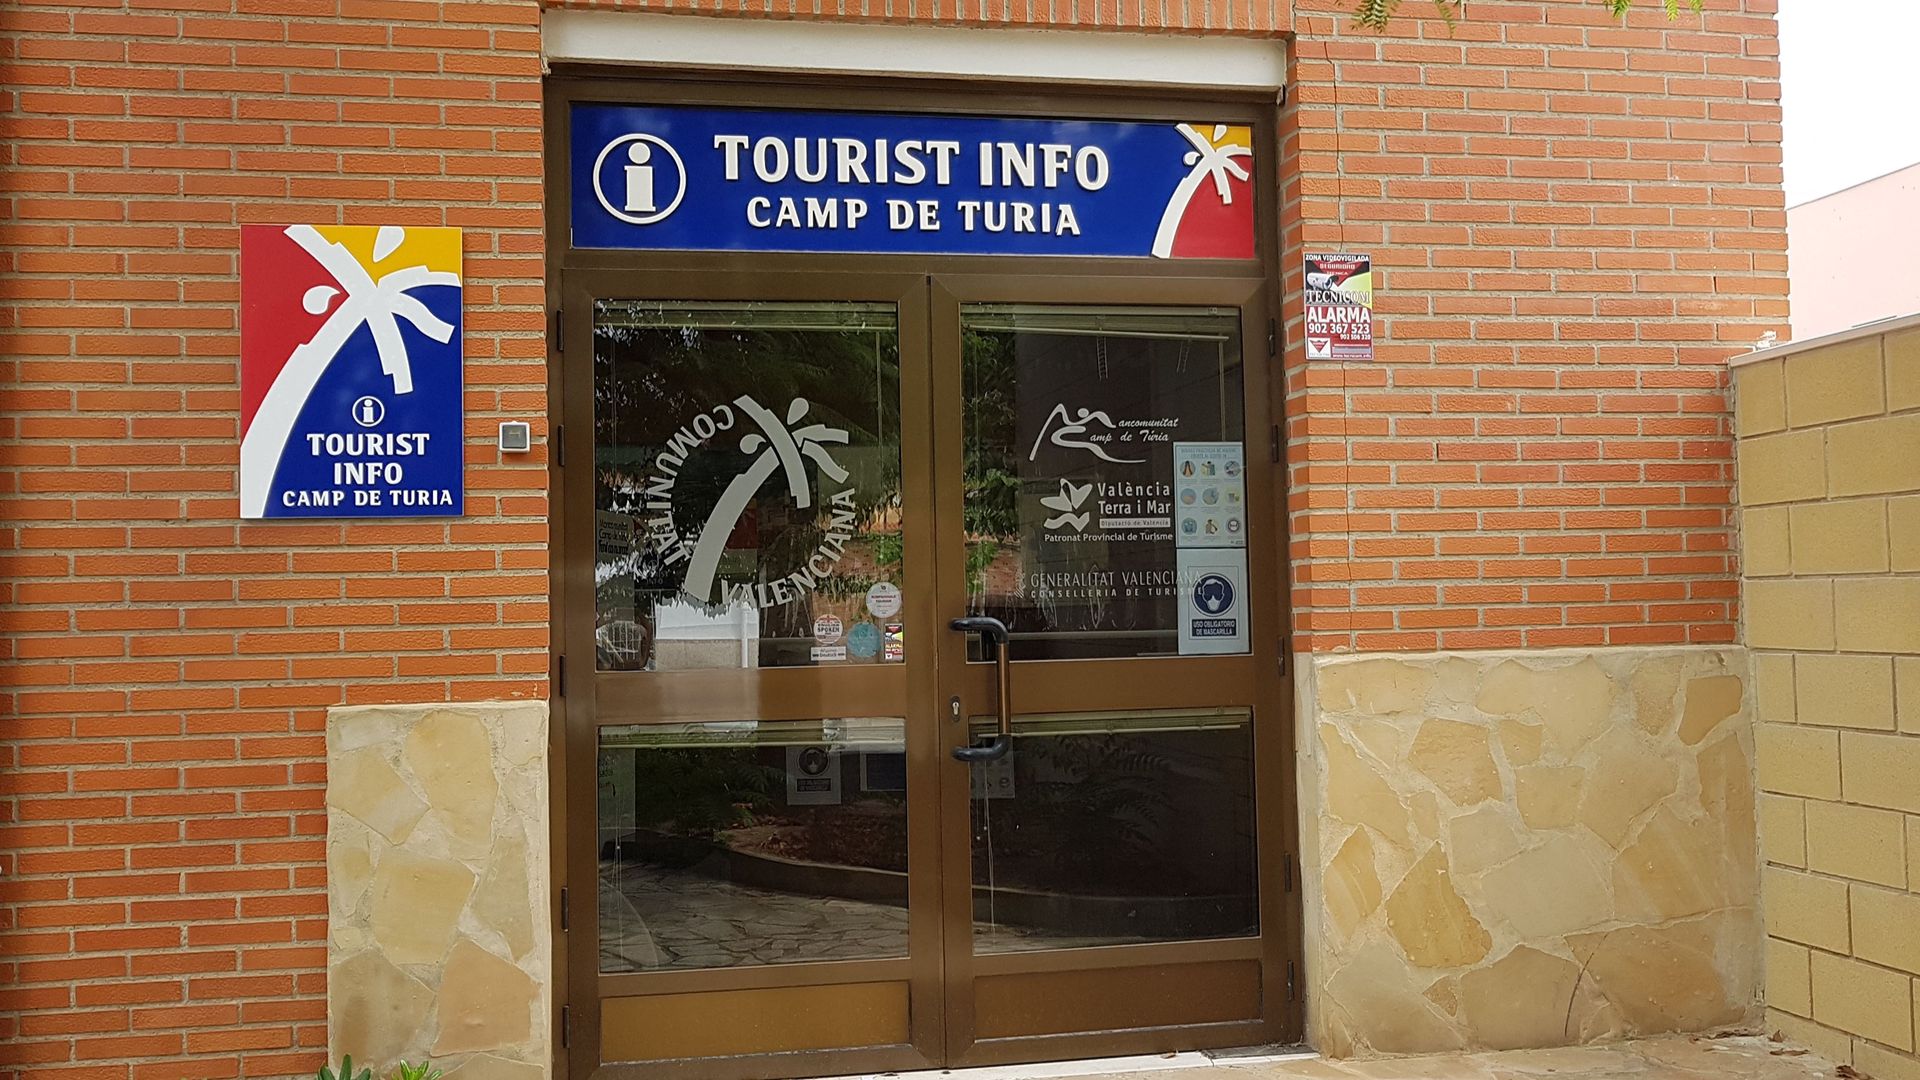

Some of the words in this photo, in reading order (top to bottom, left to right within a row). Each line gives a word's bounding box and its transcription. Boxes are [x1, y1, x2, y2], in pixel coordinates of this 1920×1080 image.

[714, 133, 960, 186] TOURIST
[980, 141, 1110, 192] INFO
[746, 196, 868, 231] CAMP
[886, 199, 941, 231] DE
[957, 200, 1081, 237] TURIA
[1305, 254, 1322, 262] ZONA
[1322, 254, 1370, 262] VIDEOVIGILADA
[1307, 306, 1371, 323] ALARMA
[1308, 323, 1328, 334] 902
[1329, 323, 1349, 334] 367
[1351, 323, 1370, 334] 523
[306, 432, 430, 457] TOURIST
[1120, 431, 1133, 442] de
[333, 462, 403, 486] INFO
[646, 404, 735, 567] COMUNITAT
[1097, 481, 1171, 497] València
[282, 490, 345, 508] CAMP
[353, 490, 382, 507] DE
[389, 489, 453, 507] TURIA
[1098, 500, 1132, 515] Terra
[1136, 500, 1142, 515] i
[1147, 500, 1171, 515] Mar
[1044, 533, 1081, 543] Patronat
[1083, 532, 1125, 542] Provincial
[1127, 532, 1138, 542] de
[1139, 531, 1174, 541] Turisme
[720, 487, 857, 609] VALENCIANA
[1031, 571, 1115, 588] GENERALITAT
[1121, 569, 1202, 587] VALENCIANA
[1030, 589, 1117, 599] CONSELLERIA
[1126, 588, 1140, 597] DE
[1193, 620, 1204, 628] USO
[1204, 619, 1236, 628] OBLIGATORIO
[1203, 627, 1232, 635] MASCARILLA
